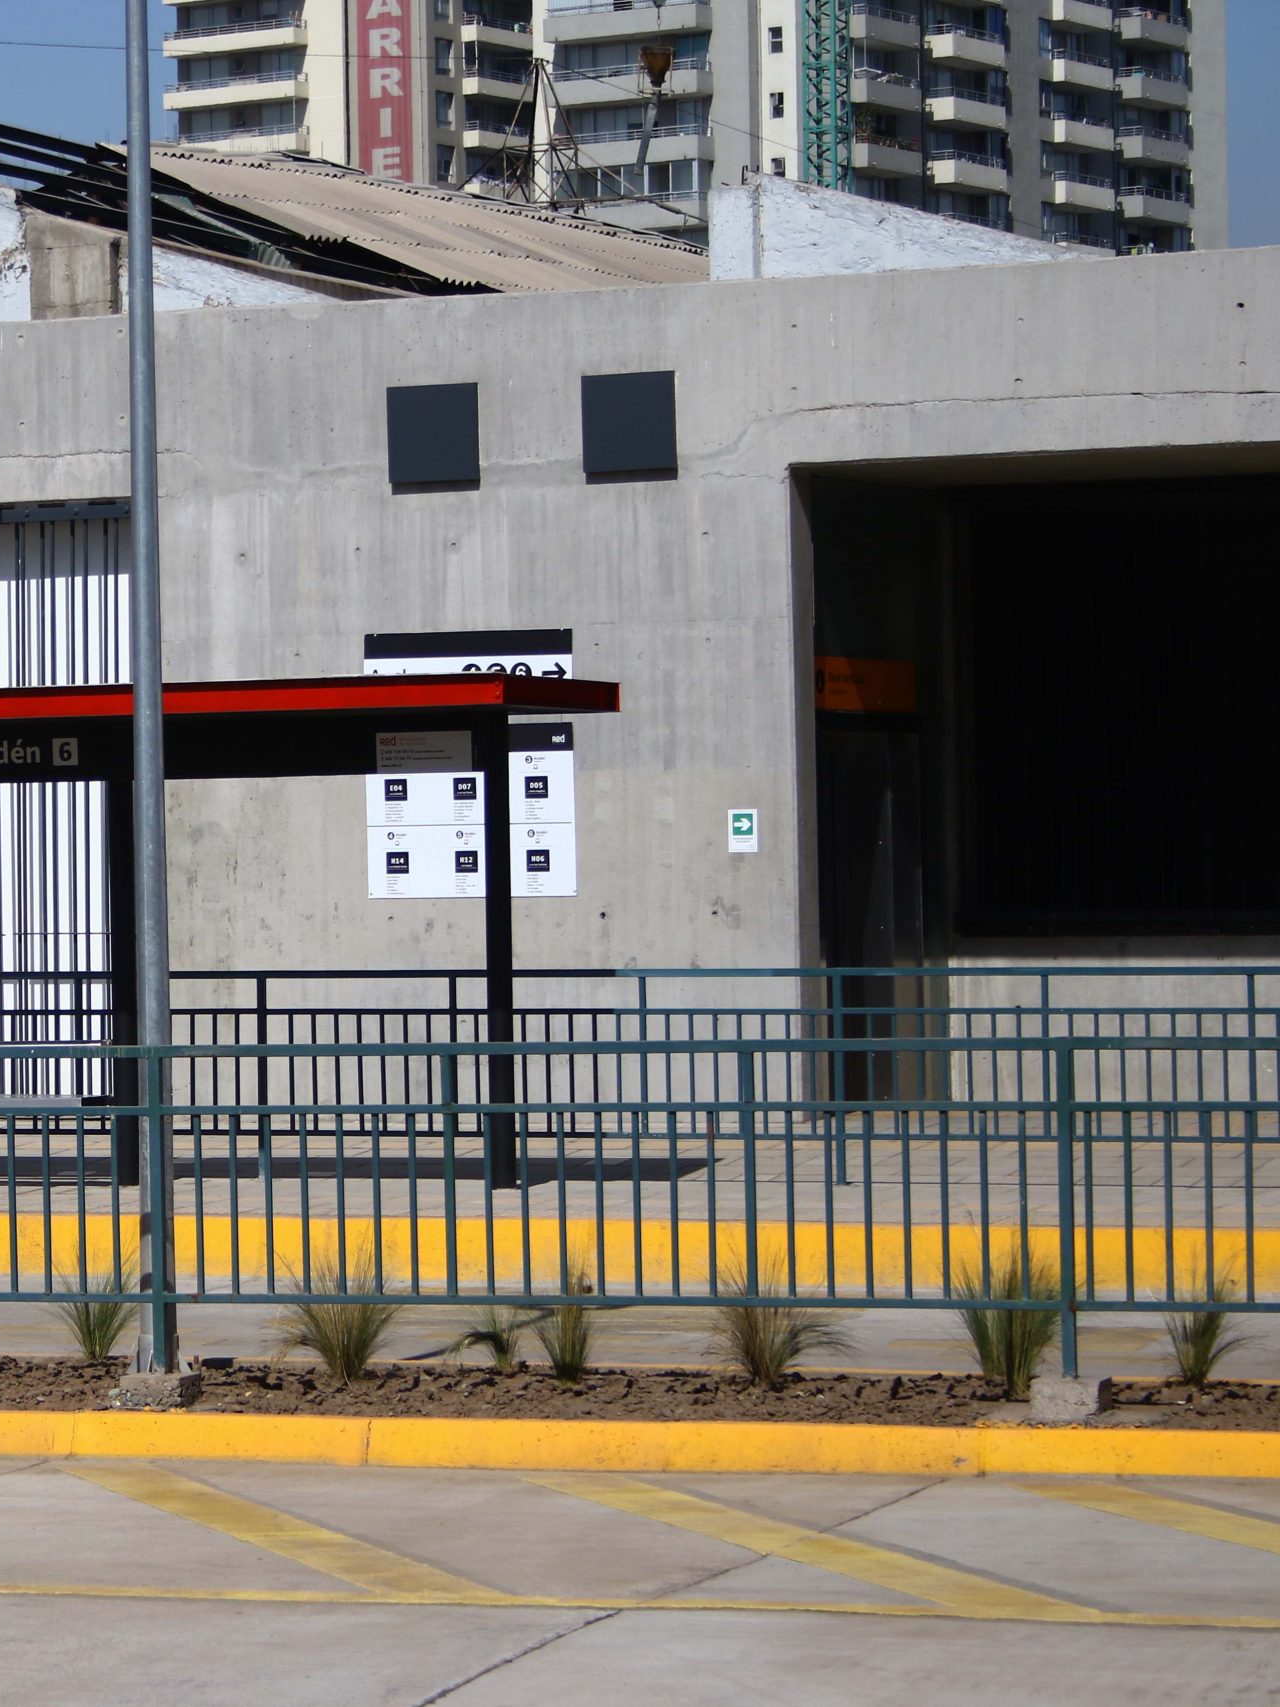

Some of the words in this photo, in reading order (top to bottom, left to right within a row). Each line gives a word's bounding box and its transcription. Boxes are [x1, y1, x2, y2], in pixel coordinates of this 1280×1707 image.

[58, 741, 73, 762] 6
[389, 784, 403, 792] E04
[529, 781, 544, 789] D05
